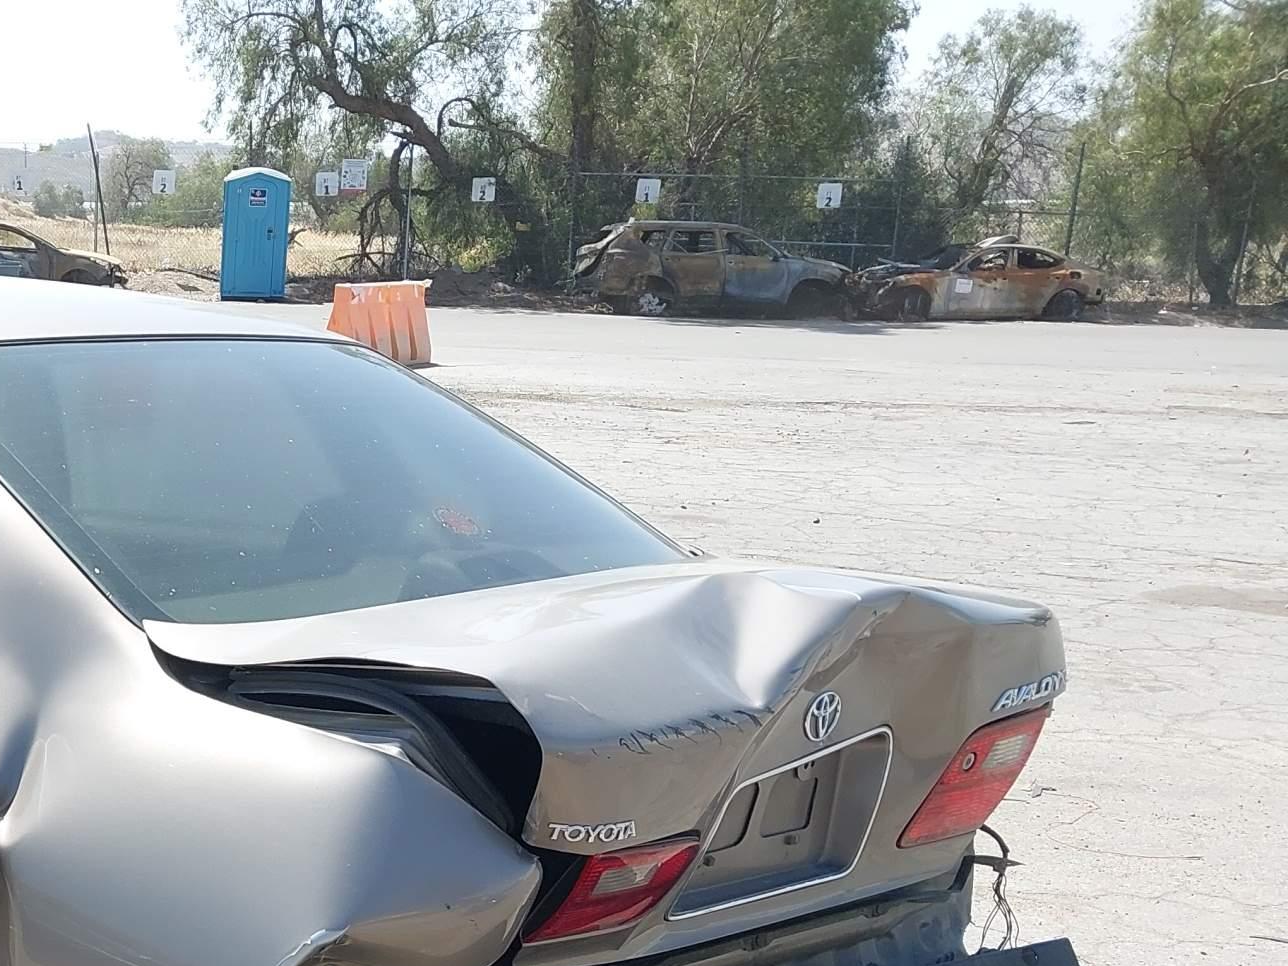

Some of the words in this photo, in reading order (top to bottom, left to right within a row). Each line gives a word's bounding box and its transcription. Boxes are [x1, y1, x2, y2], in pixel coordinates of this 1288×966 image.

[16, 181, 24, 191] 1
[160, 183, 167, 193] 2
[479, 190, 486, 200] 2
[824, 197, 832, 207] 2
[548, 820, 636, 843] TOYOTA
